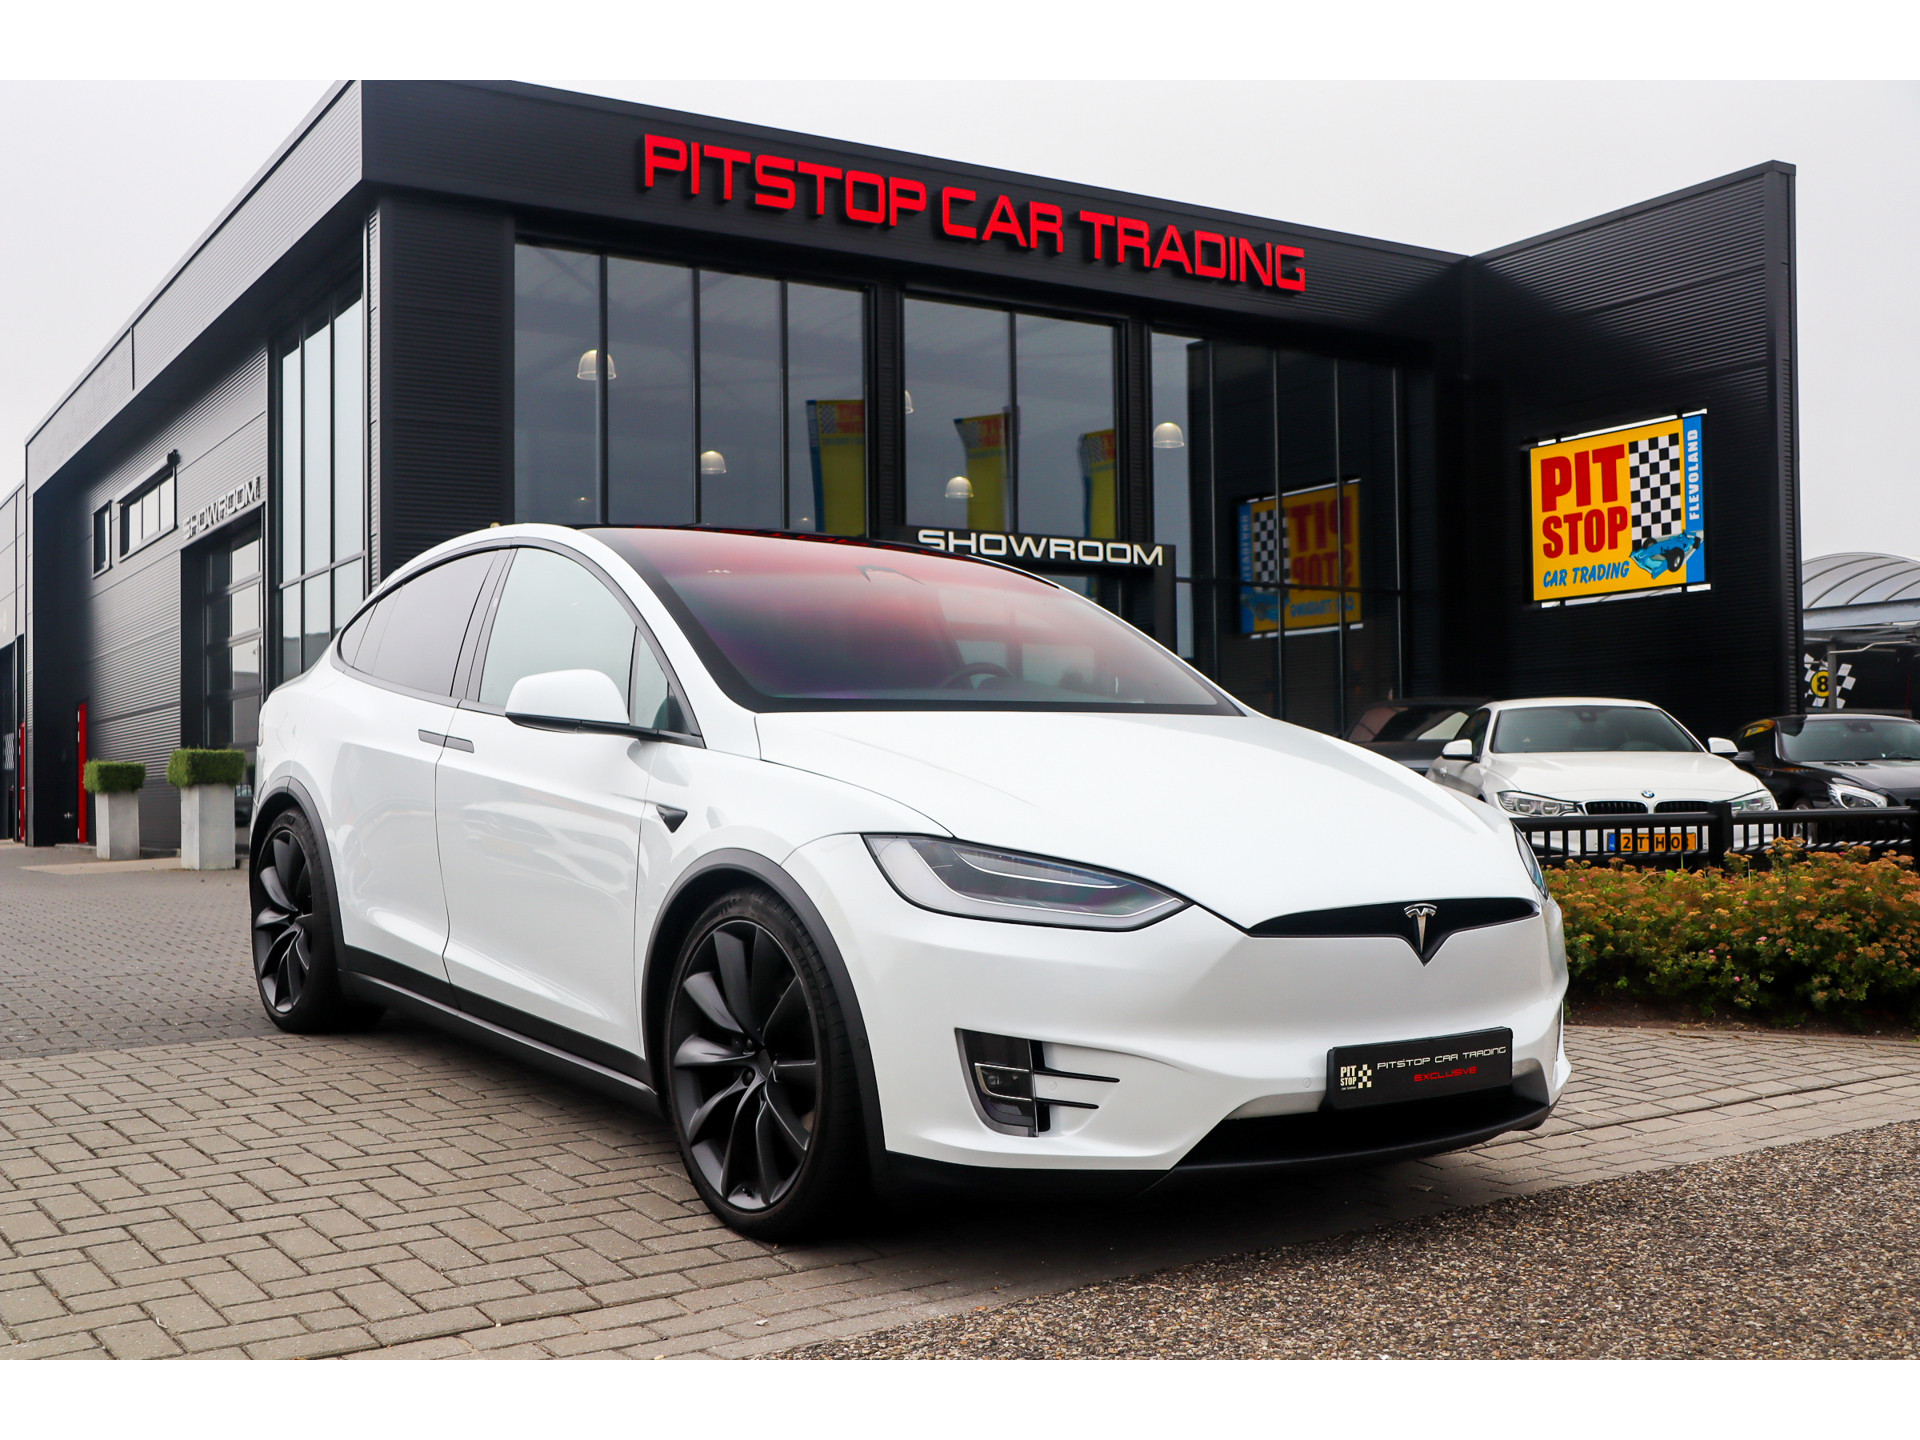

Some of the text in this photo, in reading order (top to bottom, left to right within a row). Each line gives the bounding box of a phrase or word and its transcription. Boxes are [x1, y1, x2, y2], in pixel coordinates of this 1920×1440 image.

[644, 133, 1306, 292] PITSTOP CAR TRADING
[1540, 443, 1626, 513] PIT
[1687, 429, 1700, 520] FLEVOLAND
[182, 475, 260, 540] SHOWROOM
[917, 529, 1163, 567] SHOWROOM
[1542, 505, 1628, 559] STOP
[1543, 560, 1630, 588] CAR TRADING
[1340, 1065, 1357, 1078] PIT
[1376, 1046, 1507, 1070] PITSTOP CAR TRADING
[1414, 1066, 1478, 1082] EXCLUSIVE
[1340, 1077, 1357, 1087] STOP
